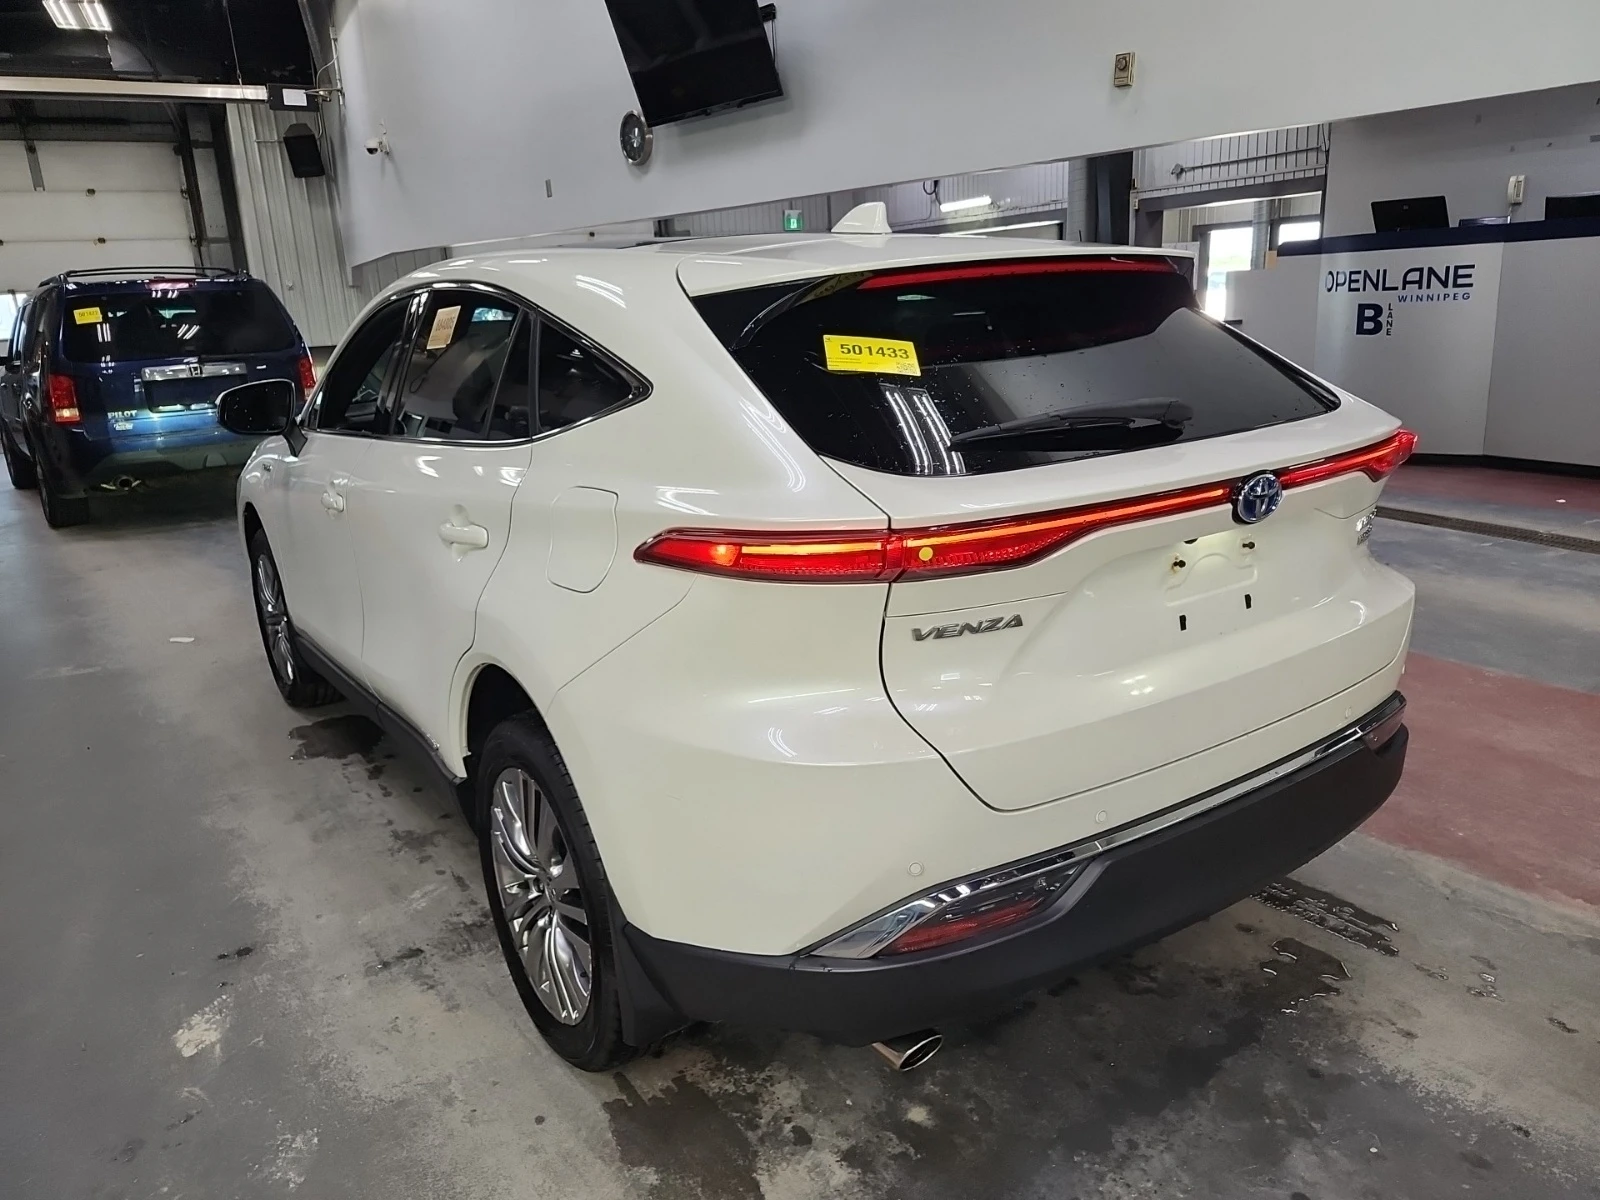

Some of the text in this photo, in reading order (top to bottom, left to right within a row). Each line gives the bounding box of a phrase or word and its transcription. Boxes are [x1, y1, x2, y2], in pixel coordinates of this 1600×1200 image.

[1325, 264, 1475, 293] OPENLANE
[1398, 292, 1471, 303] WINNIPEG
[1356, 303, 1383, 335] B
[840, 343, 910, 360] 501433
[107, 410, 138, 419] PILOT
[911, 614, 1023, 641] VENZA
